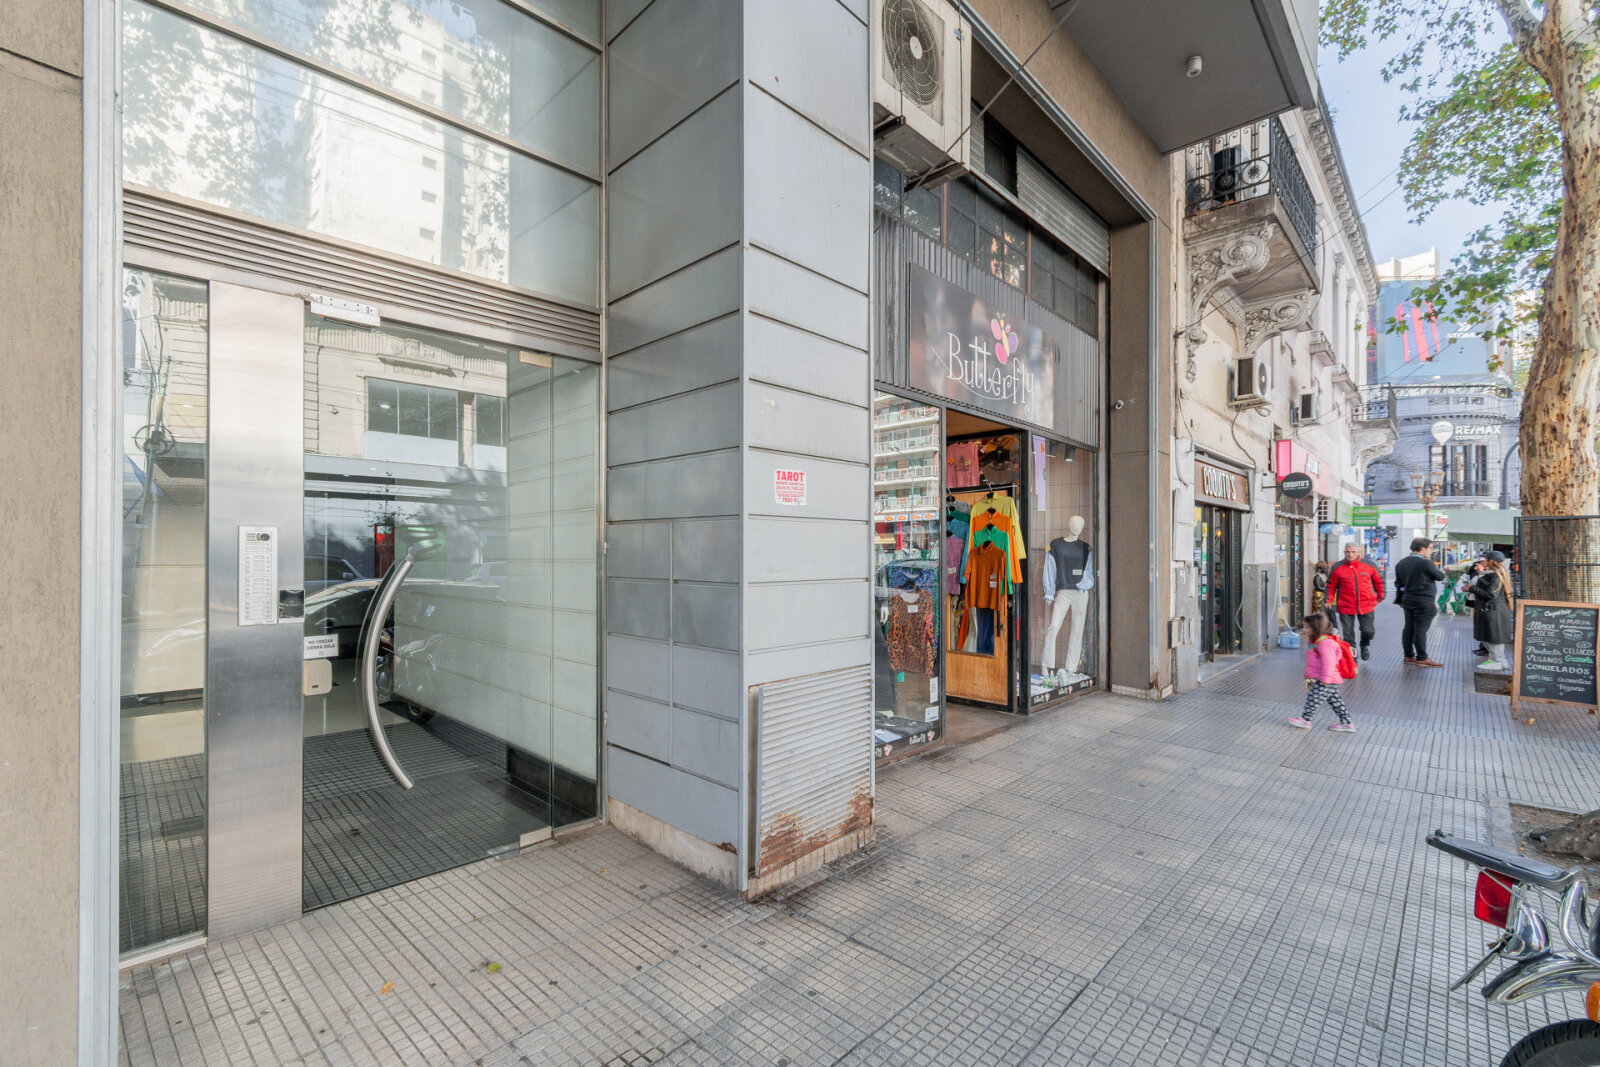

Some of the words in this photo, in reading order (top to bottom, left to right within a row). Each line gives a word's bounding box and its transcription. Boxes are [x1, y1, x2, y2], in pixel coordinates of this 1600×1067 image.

[946, 331, 1034, 418] Butterfly
[1455, 425, 1502, 435] RE/MAX
[776, 471, 805, 482] TAROT
[1526, 654, 1563, 664] VEGANOS
[1525, 663, 1591, 675] CONGELADOS
